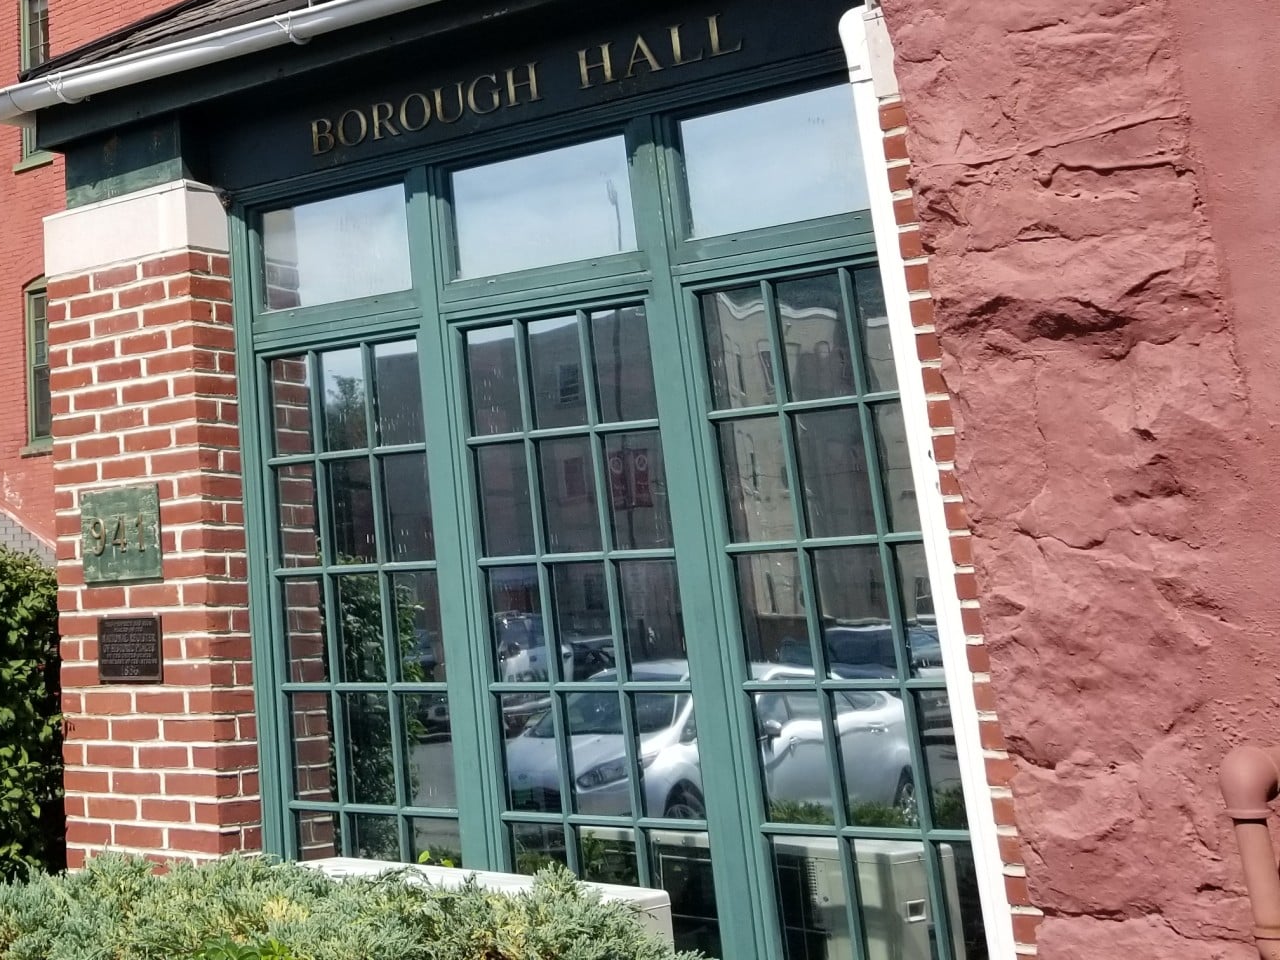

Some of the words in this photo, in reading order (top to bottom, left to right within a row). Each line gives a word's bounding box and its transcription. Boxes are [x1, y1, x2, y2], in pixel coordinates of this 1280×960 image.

[310, 61, 544, 156] BOROUGH
[577, 12, 744, 90] HALL
[90, 511, 146, 557] 941
